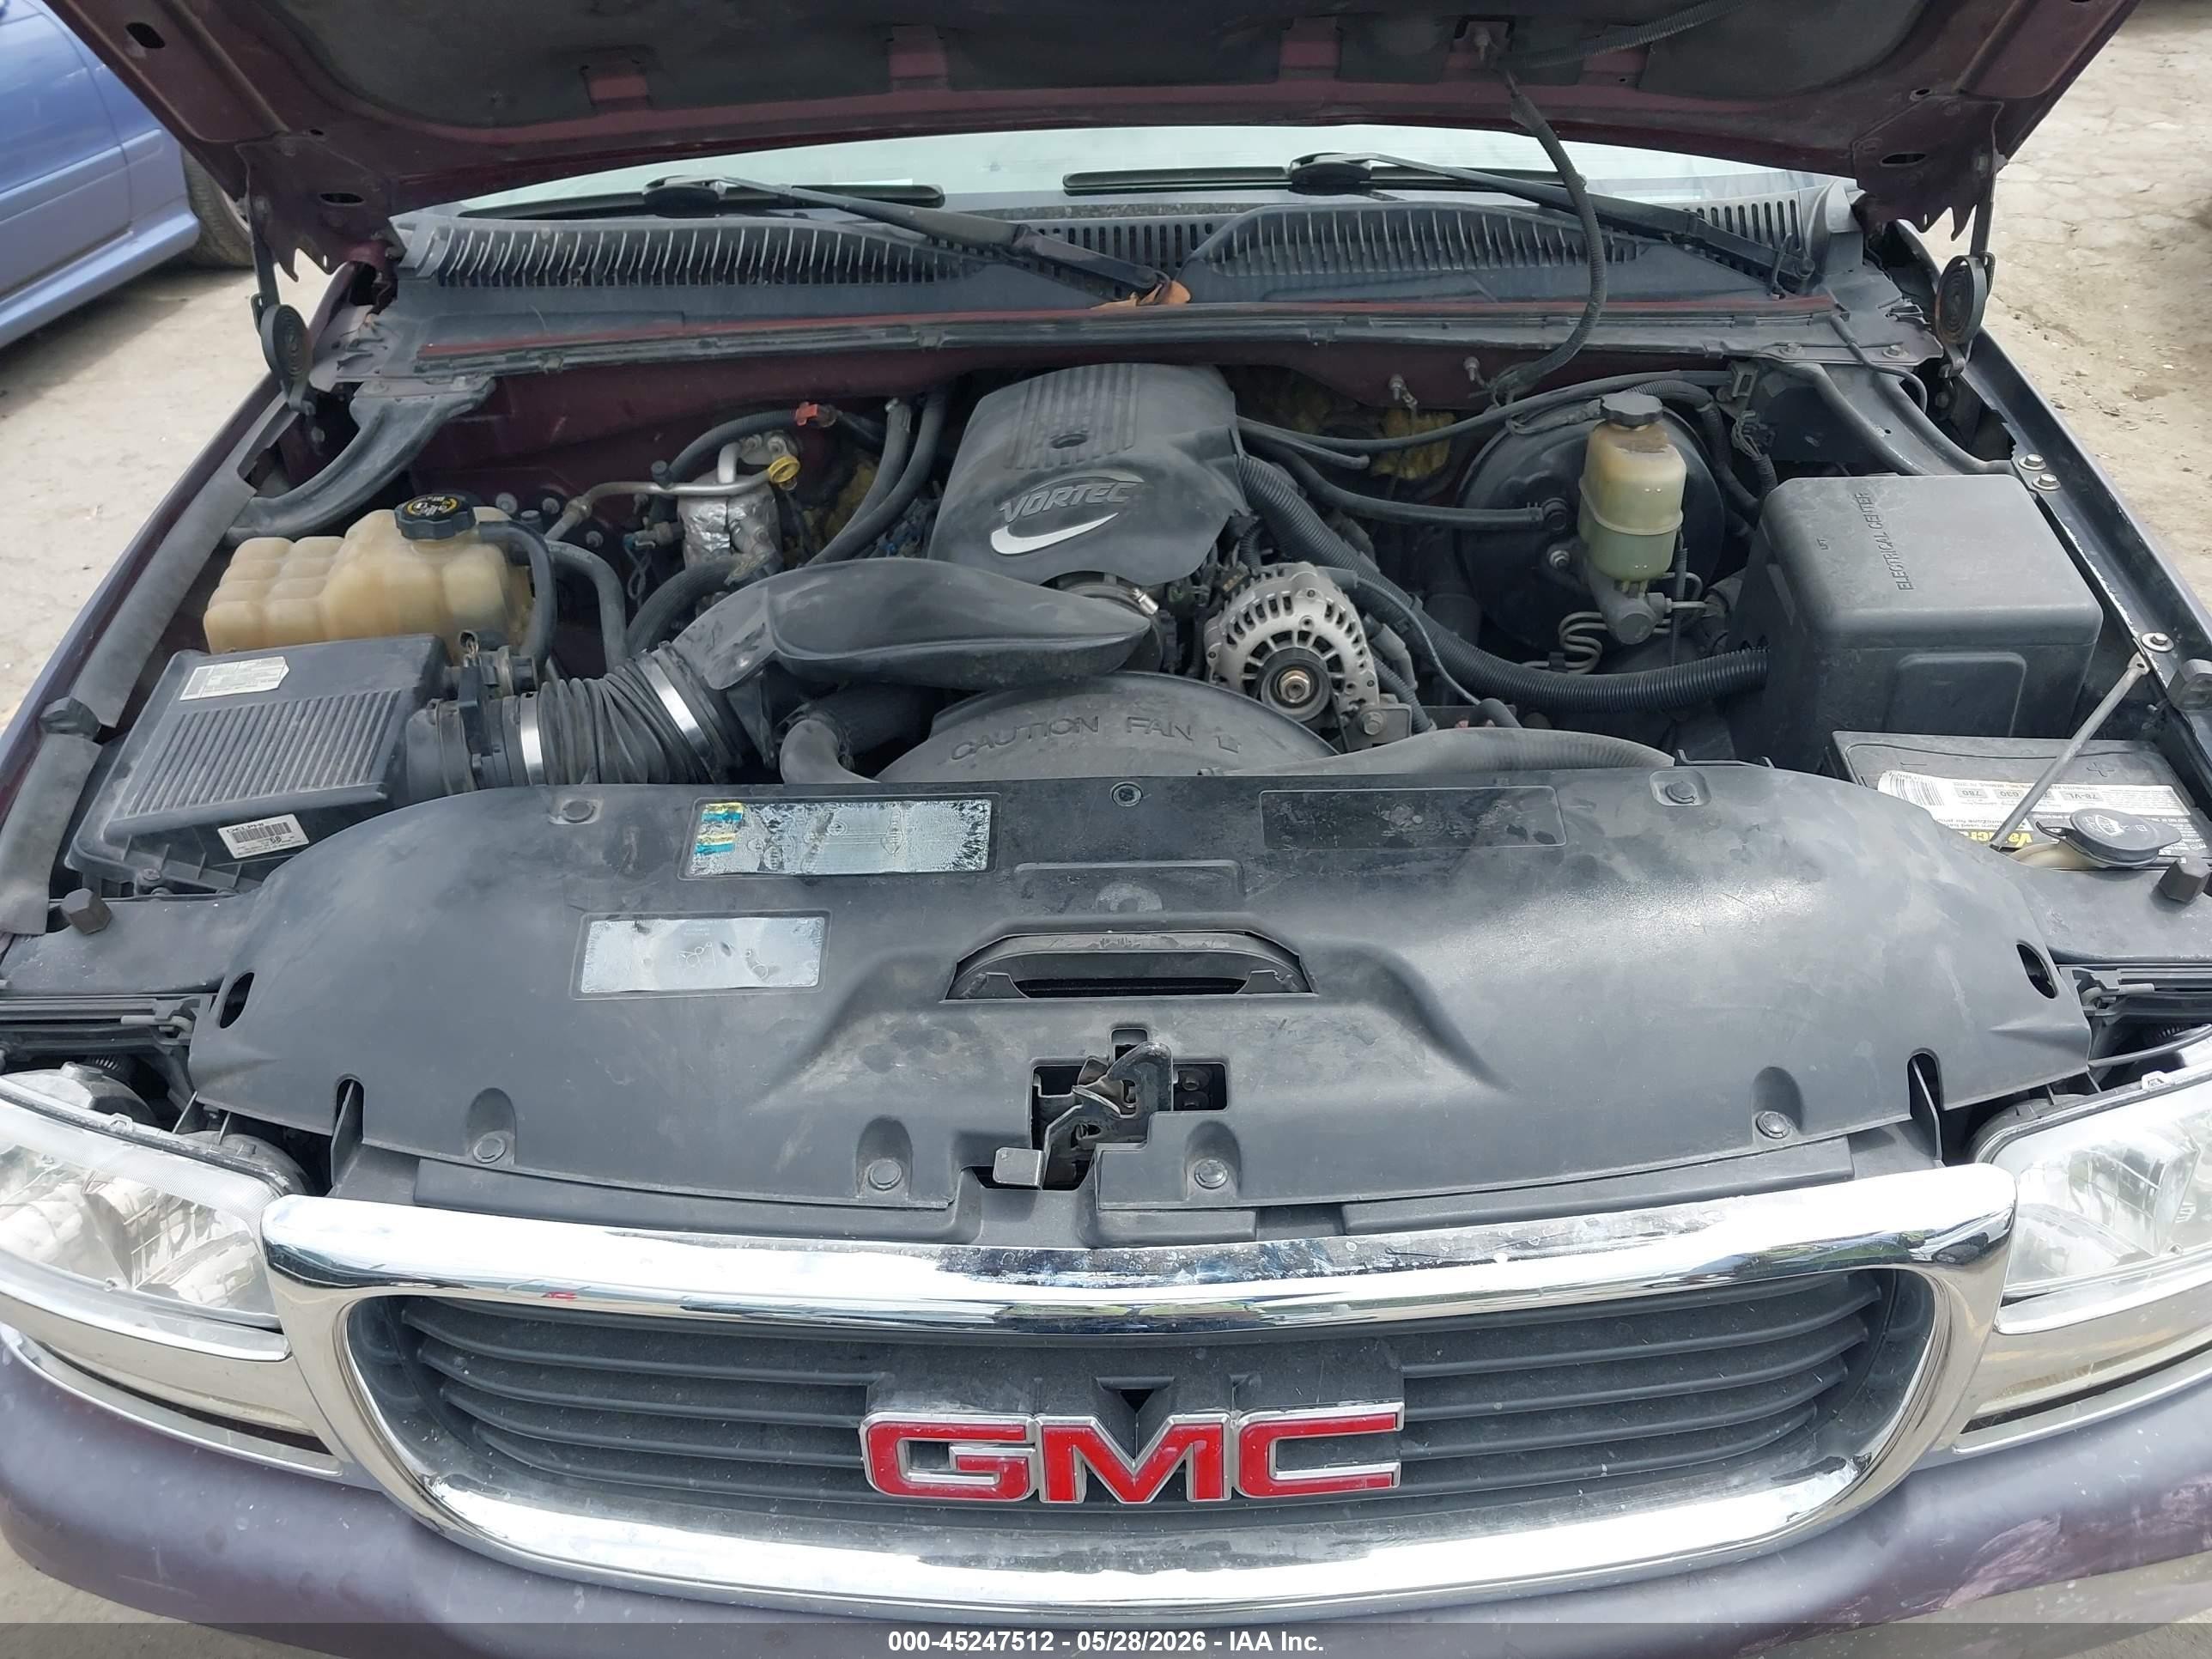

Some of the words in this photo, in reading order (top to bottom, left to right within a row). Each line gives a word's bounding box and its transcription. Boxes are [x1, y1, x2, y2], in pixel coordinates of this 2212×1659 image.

[1000, 483, 1137, 523] VORTEC
[1854, 492, 1883, 530] CENTER
[1873, 532, 1915, 592] ELECTRICAL
[951, 715, 1100, 761] CAUTION
[1127, 715, 1194, 742] FAN
[860, 1401, 1405, 1504] GMC
